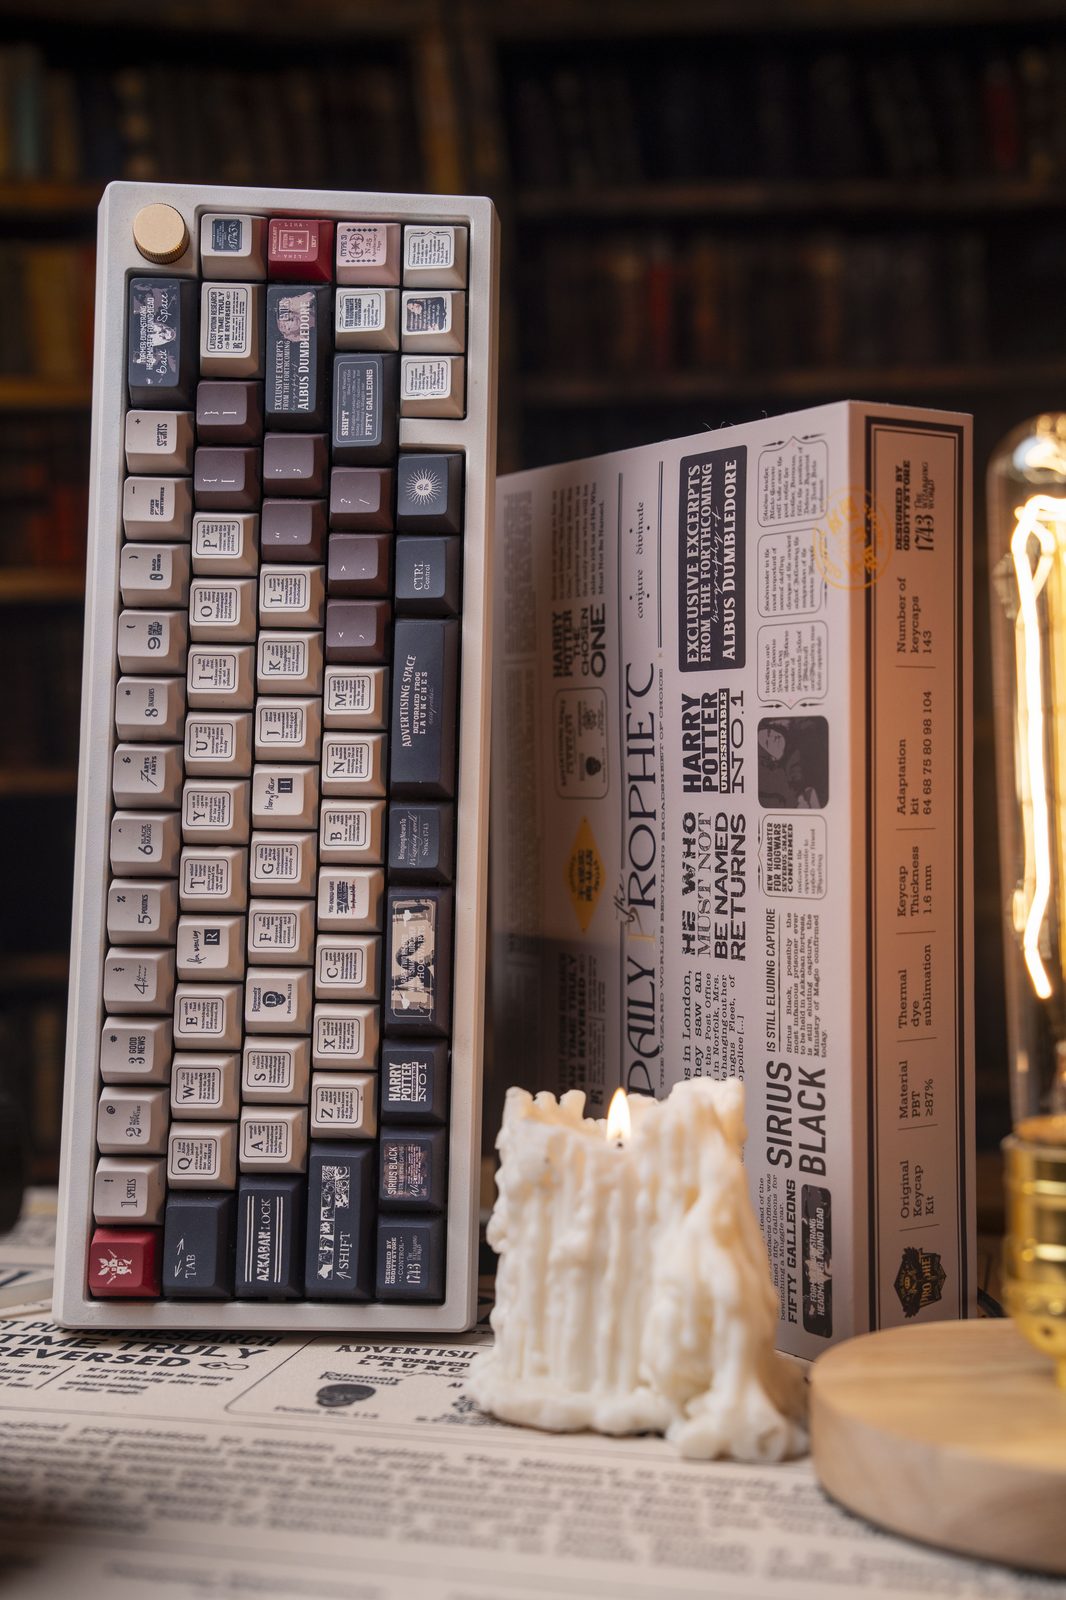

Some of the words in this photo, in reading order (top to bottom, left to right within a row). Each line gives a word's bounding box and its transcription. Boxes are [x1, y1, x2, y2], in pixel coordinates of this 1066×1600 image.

[207, 291, 217, 315] RESEARCH
[208, 316, 216, 332] POTION
[298, 302, 310, 372] DUMBLEDORE
[207, 333, 216, 350] LATEST
[275, 340, 283, 373] EXCERPTS
[298, 375, 309, 410] ALBUS
[896, 466, 902, 482] BY
[686, 465, 700, 558] EXCERPTS
[701, 463, 712, 578] FORTHCOMING
[712, 506, 722, 528] of
[722, 460, 736, 591] DUMBLEDORE
[203, 540, 217, 548] P
[914, 514, 934, 551] 1743
[414, 561, 423, 590] CTRL
[710, 530, 722, 623] biography
[897, 576, 907, 588] of
[636, 569, 645, 619] conjure
[701, 583, 711, 615] THE
[200, 606, 213, 617] O
[686, 563, 700, 664] EXCLUSIVE
[897, 592, 907, 654] Number
[910, 596, 921, 653] keycaps
[552, 610, 563, 677] HARRY
[564, 610, 573, 676] POTTER
[591, 603, 606, 677] ONE
[701, 619, 711, 662] FROM
[722, 597, 736, 660] ALBUS
[922, 630, 932, 654] 143
[269, 661, 280, 670] K
[403, 655, 416, 682] SPACE
[335, 693, 346, 707] M
[400, 684, 412, 747] ADVERTISING
[922, 691, 932, 714] 104
[682, 693, 701, 792] HARRY
[702, 692, 718, 792] POTTER
[720, 692, 728, 792] UNDESIRABLE
[730, 690, 744, 793] NO.1
[922, 719, 932, 735] 98
[922, 738, 932, 755] 80
[333, 761, 345, 773] N
[897, 739, 908, 815] Adaptation
[922, 759, 932, 774] 75
[922, 778, 932, 795] 68
[193, 811, 206, 821] Y
[626, 663, 656, 943] PROPHET
[910, 798, 919, 815] kit
[922, 799, 932, 815] 64
[138, 844, 153, 855] 6
[682, 812, 696, 896] WHO
[698, 812, 712, 872] NOT
[262, 863, 274, 874] G
[714, 812, 728, 915] NAMED
[925, 864, 932, 891] mm
[190, 877, 205, 888] T
[730, 814, 746, 961] RETURNS
[898, 865, 908, 917] Keycap
[910, 846, 920, 916] Thickness
[138, 915, 151, 924] 5
[698, 879, 712, 958] MUST
[922, 895, 932, 914] 1.6
[682, 910, 696, 955] HE
[714, 922, 728, 959] BE
[766, 908, 775, 956] CAPTURE
[327, 968, 338, 978] C
[695, 971, 701, 993] an
[766, 960, 776, 1006] ELUDING
[922, 944, 932, 1026] sublimation
[682, 971, 692, 1040] London,
[898, 968, 908, 1029] Thermal
[910, 1001, 921, 1027] dye
[186, 1017, 198, 1026] E
[626, 956, 660, 1098] DAILY
[766, 1010, 775, 1038] STILL
[129, 1037, 138, 1054] GOOD
[138, 1036, 146, 1054] NEWS
[683, 1046, 690, 1061] in
[766, 1042, 775, 1052] IS
[389, 1063, 401, 1101] HARRY
[401, 1063, 411, 1101] POTTER
[713, 1061, 719, 1072] in
[182, 1085, 195, 1100] W
[898, 1061, 908, 1119] Material
[911, 1091, 921, 1117] PBT
[321, 1108, 333, 1118] Z
[766, 1060, 793, 1168] SIRIUS
[799, 1064, 826, 1176] BLACK
[251, 1141, 263, 1152] A
[388, 1147, 398, 1169] BLACK
[178, 1157, 193, 1170] Q
[388, 1171, 398, 1195] SIRIUS
[900, 1160, 911, 1219] Original
[913, 1165, 924, 1217] Keycap
[260, 1198, 271, 1230] LOCK
[924, 1196, 934, 1215] Kit
[786, 1179, 796, 1269] GALLEONS
[257, 1232, 271, 1281] AZKABAN
[339, 1231, 352, 1269] SHIFT
[386, 1240, 391, 1249] BY
[185, 1254, 196, 1278] TAB
[788, 1274, 797, 1324] FIFTY
[1, 1334, 107, 1349] TIME
[118, 1340, 270, 1359] TRULY
[364, 1355, 470, 1367] DEFORMED
